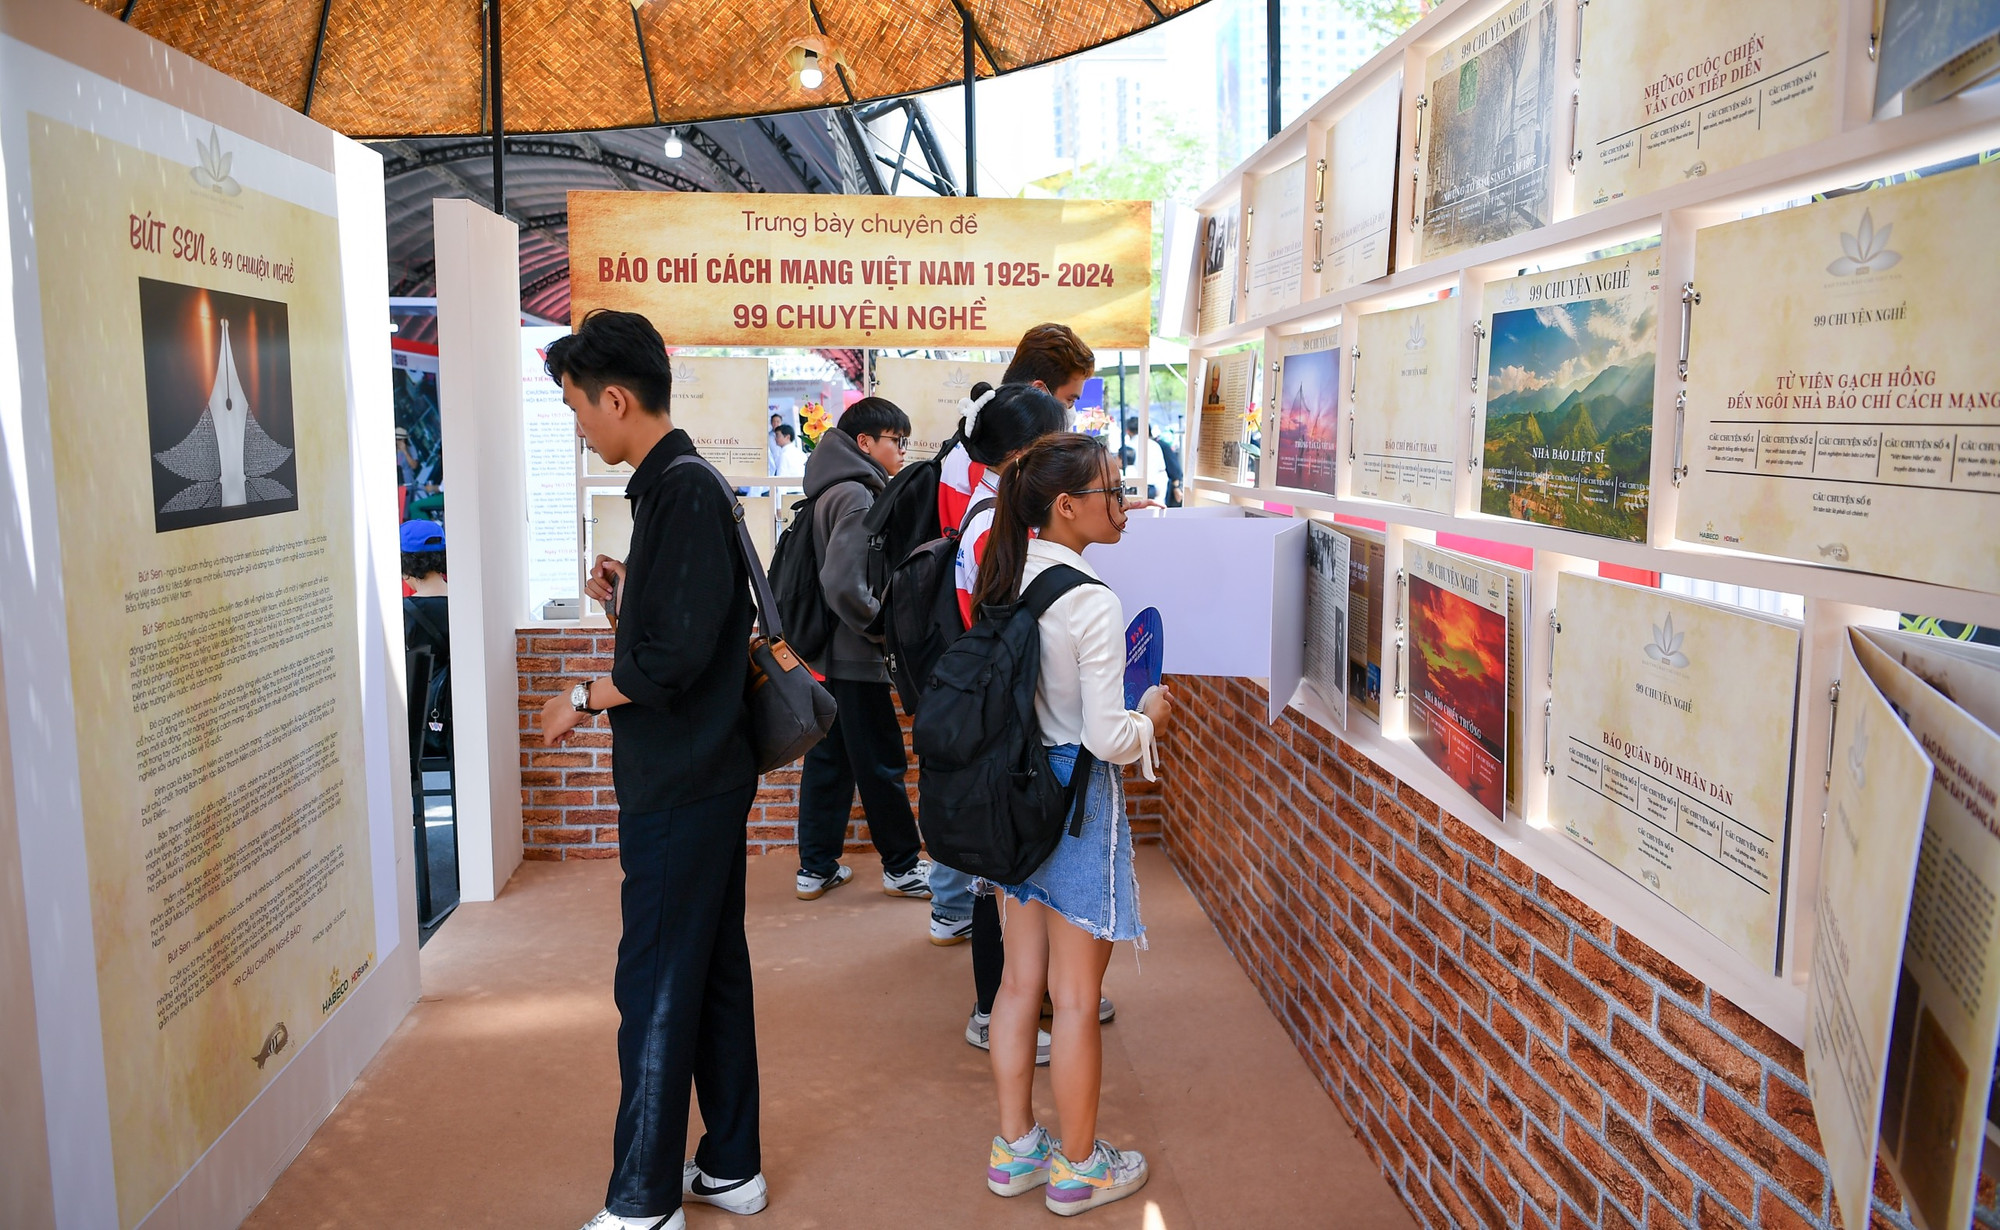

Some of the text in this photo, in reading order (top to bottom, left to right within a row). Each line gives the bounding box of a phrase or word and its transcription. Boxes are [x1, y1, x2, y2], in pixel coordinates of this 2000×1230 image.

[1461, 17, 1506, 58] 99 CHUYỆN
[1644, 32, 1765, 100] NHỮNG CUỘC CHIẾN
[1645, 56, 1762, 116] VẪN CÒN TIẾP DIỄN
[741, 209, 978, 237] Trưng bày chuyên đề
[128, 210, 296, 284] BÚT SEN & 99 CHUYỆN NGHỀ
[598, 252, 1114, 292] BÁO CHÍ CÁCH MẠNG VIỆT NAM 1925- 2024
[1529, 260, 1631, 302] 99 CHUYỆN NGHỀ
[733, 296, 987, 337] 99 CHUYỆN NGHỀ
[1814, 300, 1908, 328] 99 CHUYỆN NGHỀ
[1776, 364, 1936, 392] TỪ VIÊN GẠCH HỒNG
[1727, 388, 2000, 412] ĐẾN NGÔI NHÀ BÁO CHÍ CÁCH MẠNG
[714, 436, 739, 445] CHIẾN
[1761, 434, 1808, 445] CÂU CHUYỆN SỐ
[1818, 436, 1830, 446] CÂU
[1832, 436, 1861, 448] CHUYỆN
[1862, 436, 1872, 447] SỐ
[1885, 439, 1898, 448] CÂU
[1900, 439, 1932, 450] CHUYỆN
[1933, 439, 1944, 450] SỐ
[1961, 440, 1976, 450] CÂU
[1532, 444, 1604, 465] NHÀ BÁO LIỆT SĨ
[1813, 491, 1826, 501] CÂU
[1827, 493, 1854, 506] CHUYỆN
[1856, 495, 1866, 505] SỐ
[1699, 532, 1719, 540] HABECO
[138, 571, 149, 582] Bút
[150, 569, 163, 580] Sen
[1427, 561, 1479, 596] 99 CHUYỆN NGHỀ
[142, 624, 152, 636] Bút
[154, 622, 166, 632] Sen
[1635, 683, 1693, 713] 99 CHUYỆN NGHỀ
[1603, 732, 1733, 806] BÁO QUÂN ĐỘI NHÂN DÂN
[168, 941, 190, 964] Bút Sen
[322, 960, 369, 1014] HABECO HDBank
